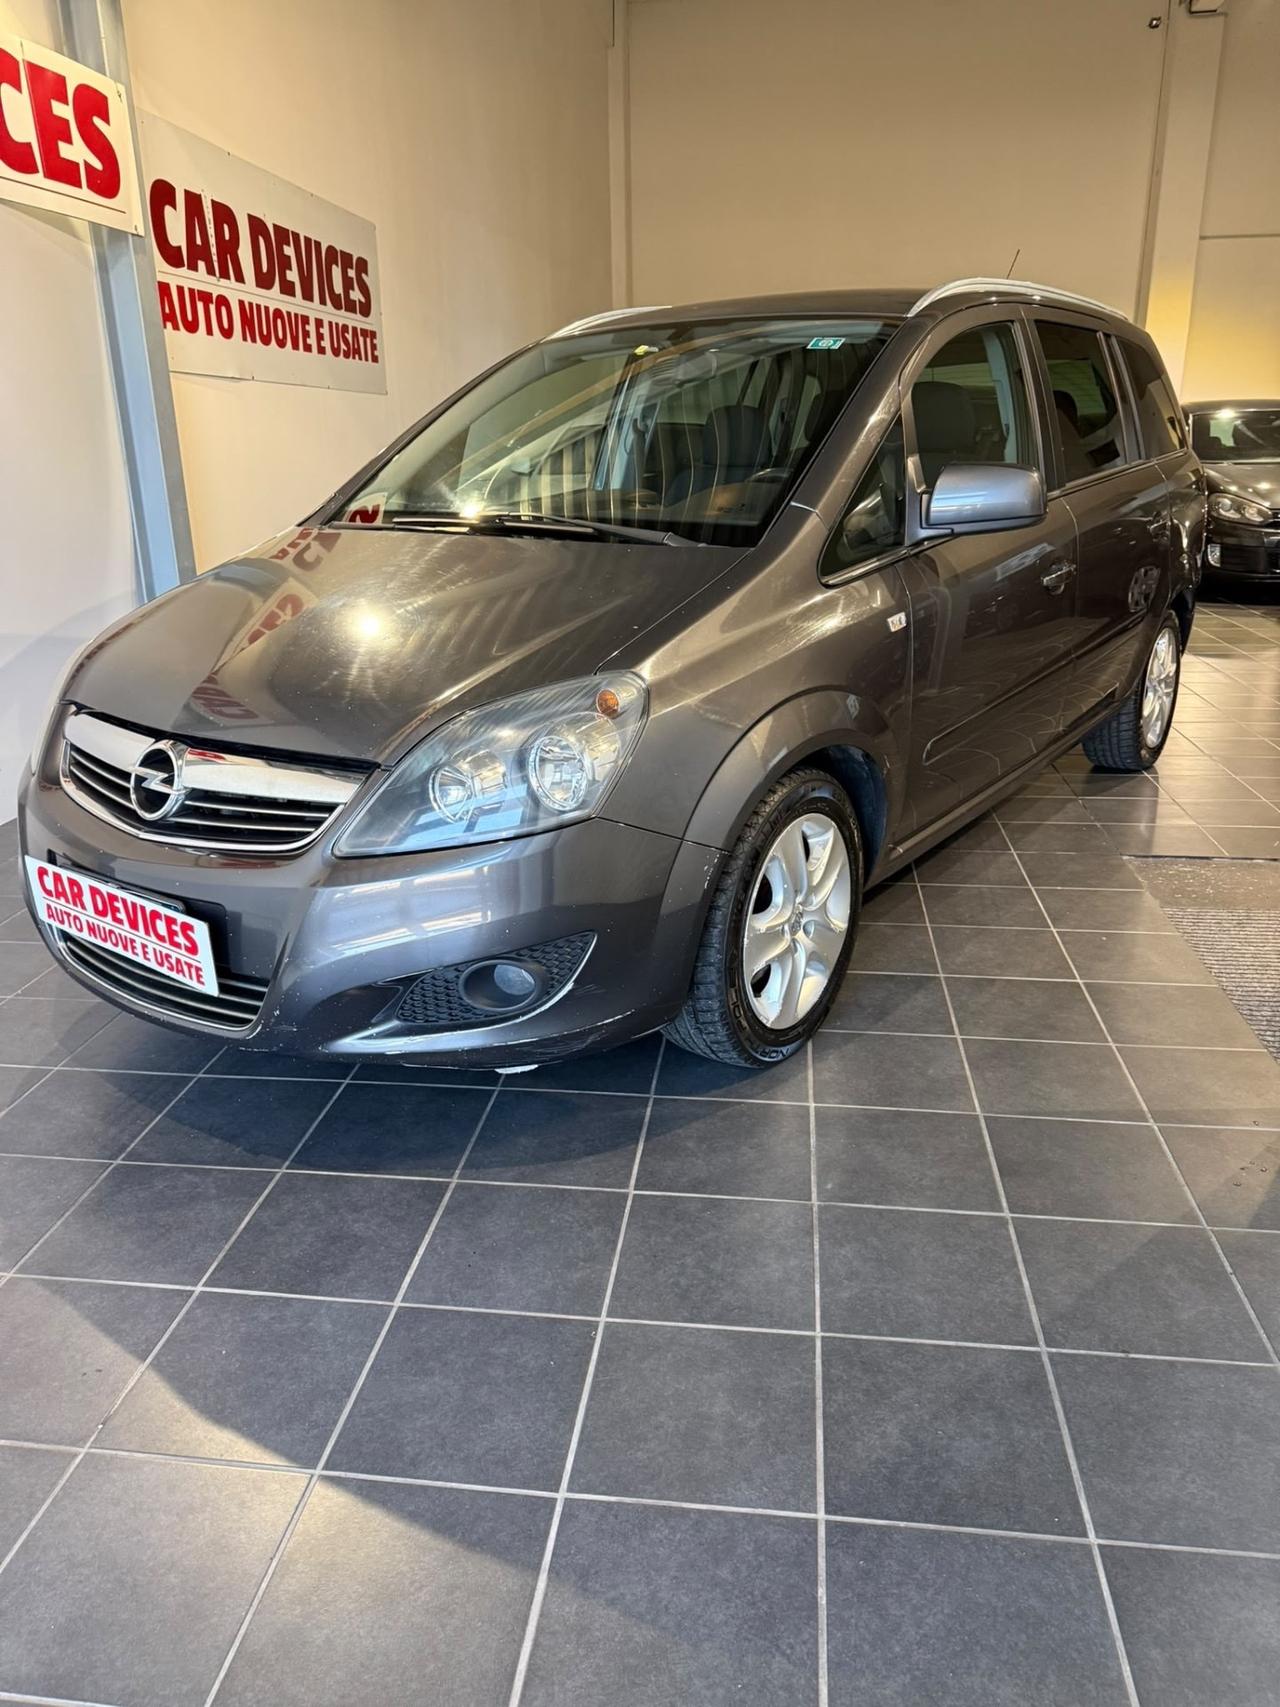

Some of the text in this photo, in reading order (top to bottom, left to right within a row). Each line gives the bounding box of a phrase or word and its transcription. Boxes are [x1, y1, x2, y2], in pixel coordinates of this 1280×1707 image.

[148, 178, 373, 319] CAR DEVICES
[156, 280, 380, 364] AUTO NUOVE E USATE
[37, 865, 200, 957] CAR DEVICES
[46, 902, 206, 987] AUTO NUOVE E USATE
